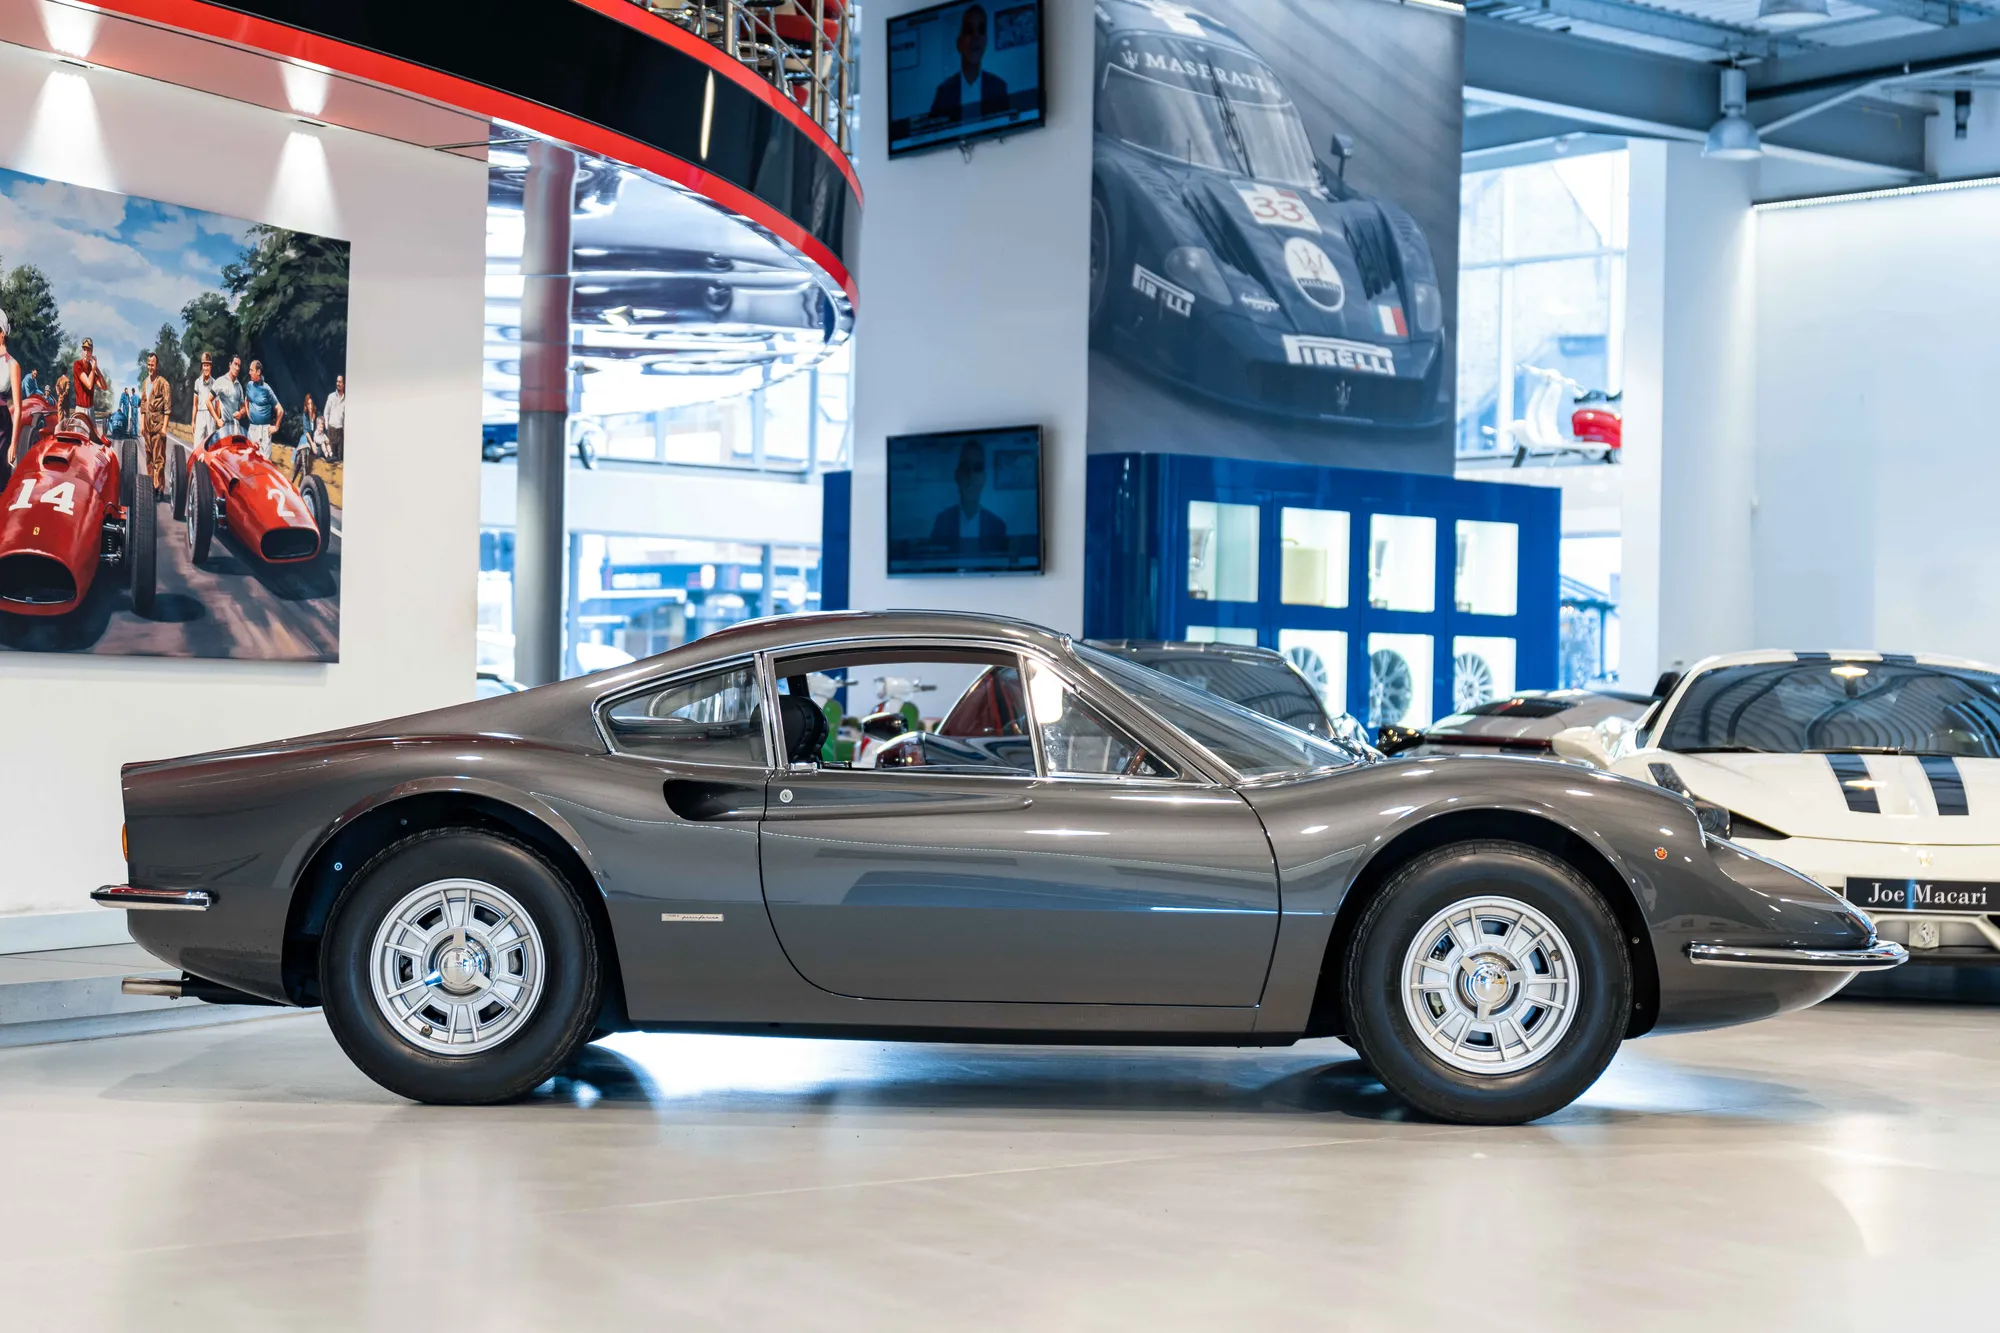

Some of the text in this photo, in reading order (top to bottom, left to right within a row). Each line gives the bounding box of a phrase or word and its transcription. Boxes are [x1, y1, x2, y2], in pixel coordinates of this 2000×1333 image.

[1145, 51, 1267, 93] MASERATI
[1252, 196, 1305, 223] 33
[1282, 334, 1396, 377] PIRELLI
[8, 478, 75, 516] 14
[266, 488, 296, 518] 2
[1868, 882, 1987, 905] Joe Macari
